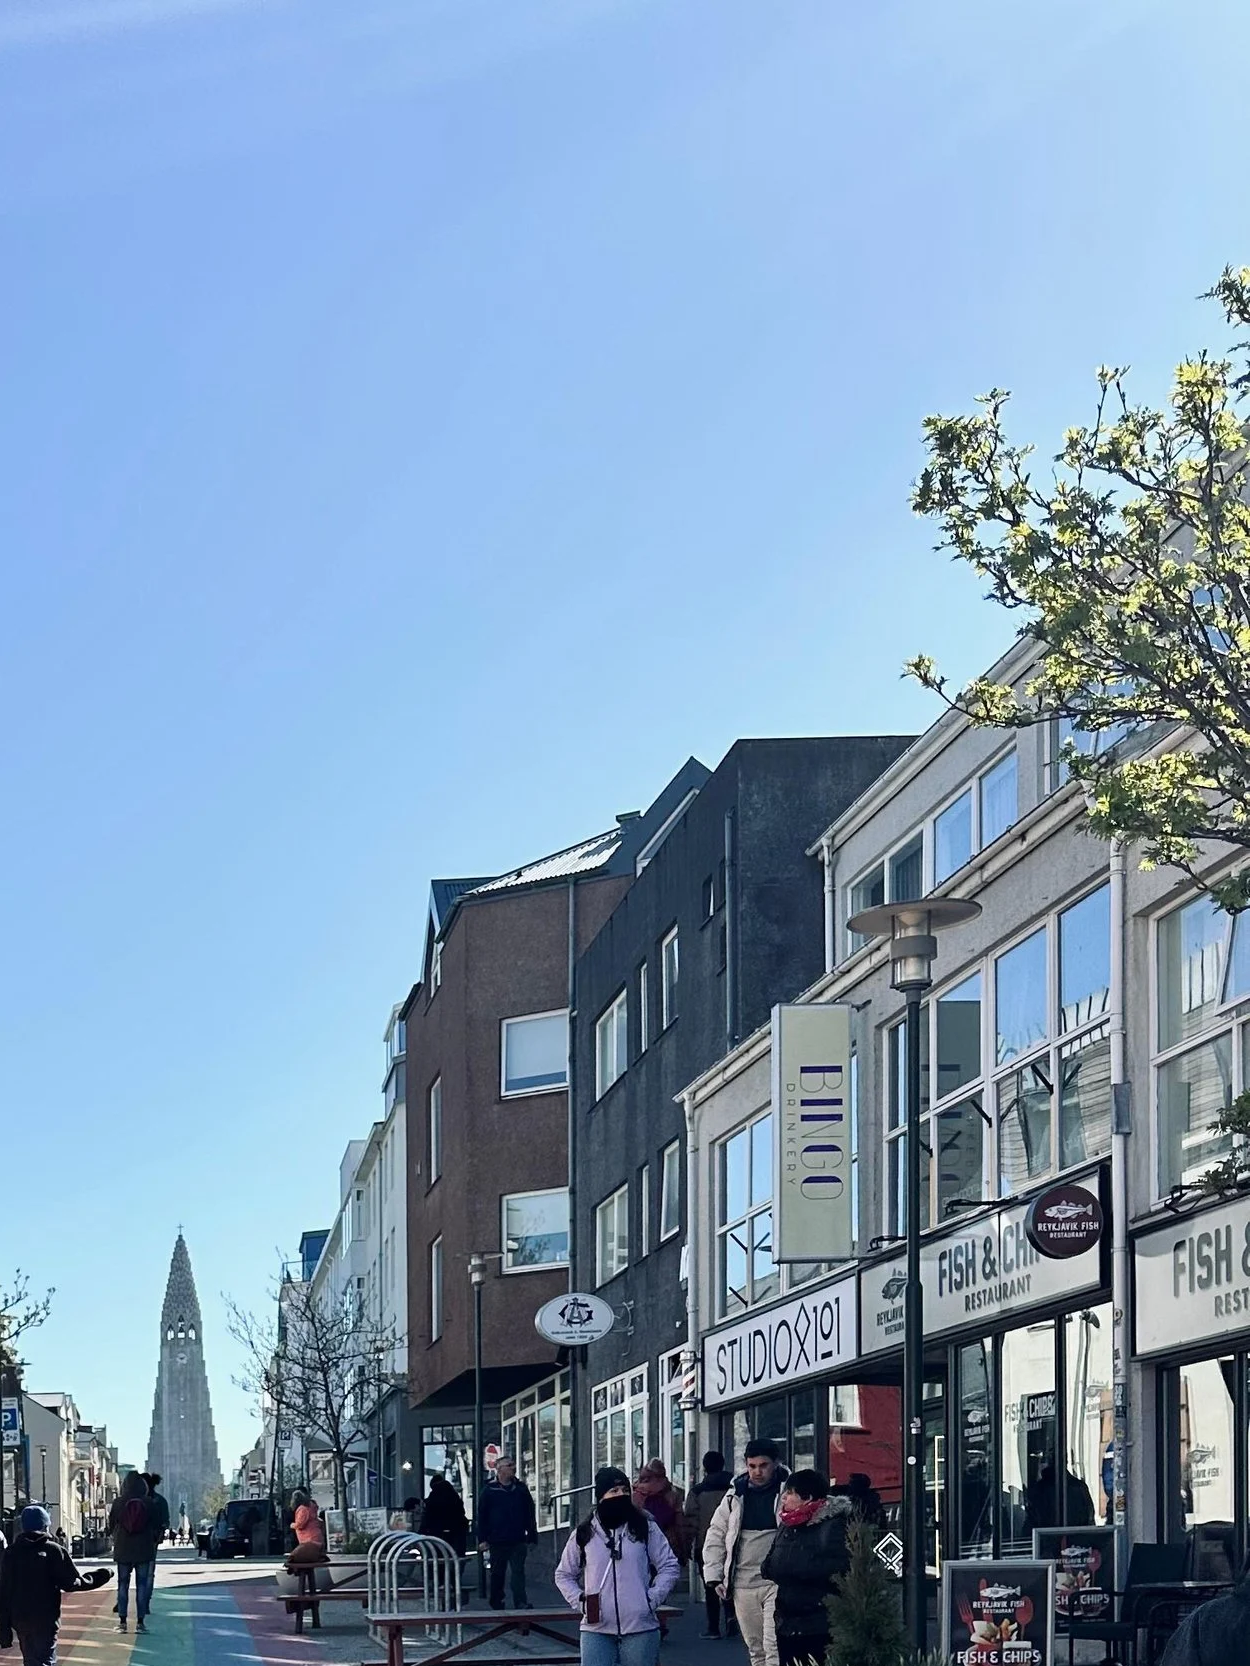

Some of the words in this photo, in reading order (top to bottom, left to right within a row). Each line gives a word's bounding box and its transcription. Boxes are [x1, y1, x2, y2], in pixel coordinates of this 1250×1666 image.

[786, 1083, 797, 1186] DRINKERY
[800, 1065, 844, 1200] BINGO
[1037, 1222, 1079, 1231] REYKJAVIK
[1081, 1221, 1099, 1230] FISH
[1049, 1231, 1087, 1239] RESTAURANT
[938, 1239, 977, 1298] FISH
[981, 1235, 998, 1281] &
[1173, 1224, 1233, 1299] FISH
[964, 1274, 1032, 1313] RESTAURANT
[1214, 1287, 1250, 1318] REST
[2, 1412, 12, 1425] P
[972, 1601, 1008, 1609] REYKJAVIK
[1055, 1595, 1069, 1606] SH
[1080, 1593, 1110, 1605] CHIPS
[957, 1651, 987, 1664] FISH
[990, 1651, 999, 1664] &
[1003, 1650, 1040, 1664] CHIPS
